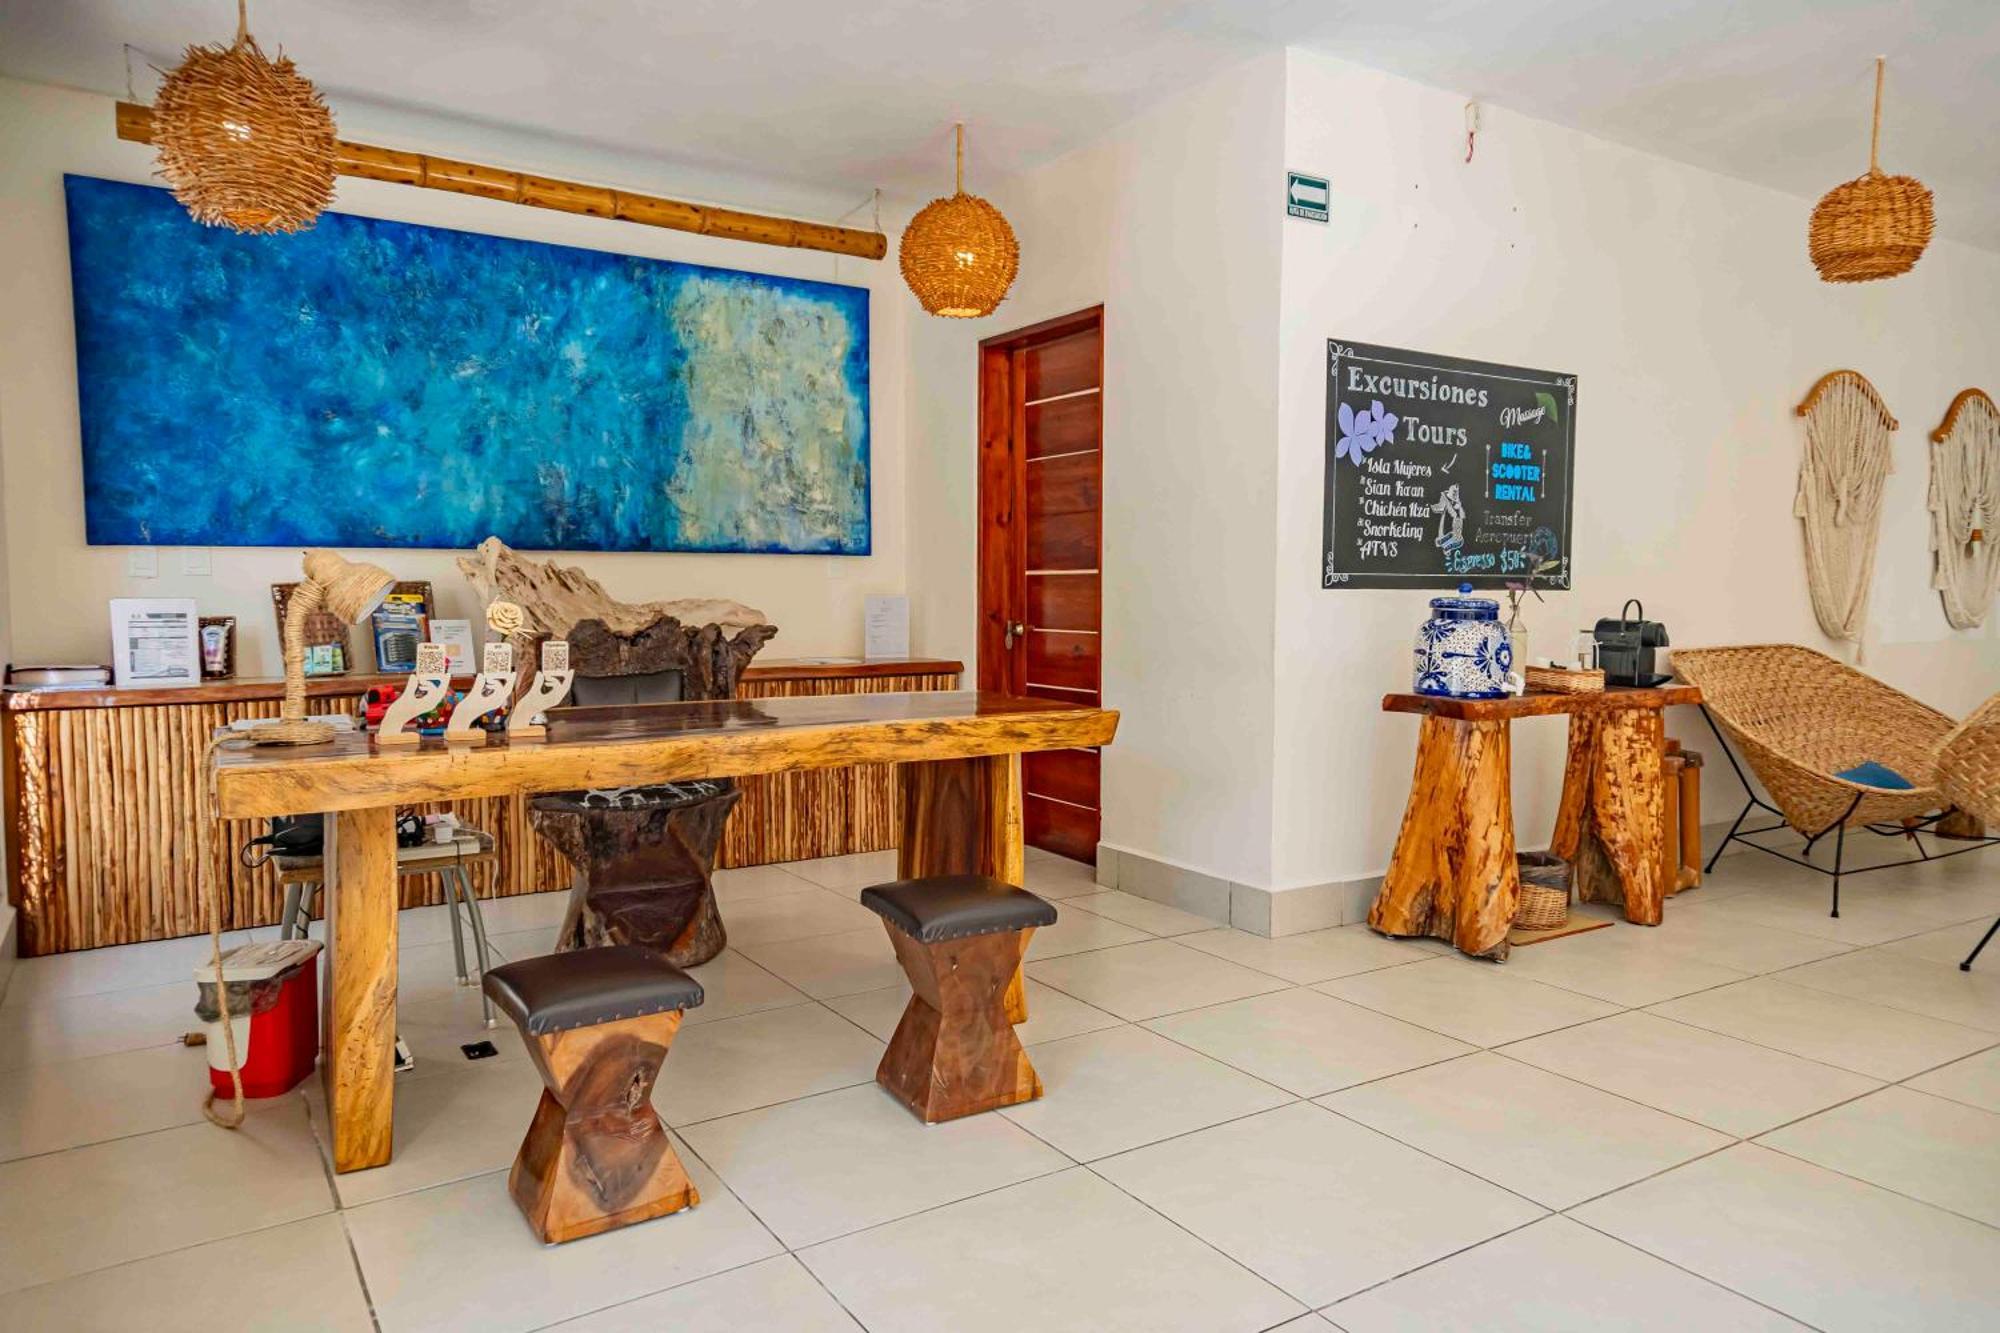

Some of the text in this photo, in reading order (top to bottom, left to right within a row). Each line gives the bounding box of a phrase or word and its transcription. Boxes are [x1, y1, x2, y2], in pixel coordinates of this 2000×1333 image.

[1347, 366, 1489, 408] Excursiones
[1402, 416, 1468, 447] Tours
[1367, 457, 1433, 479] Isla Mujeres
[1492, 463, 1541, 482] SCOOTER
[1364, 478, 1391, 496] Sian
[1495, 483, 1536, 503] RENTAL
[1364, 499, 1407, 518] Chichén
[1483, 510, 1533, 527] Transfer
